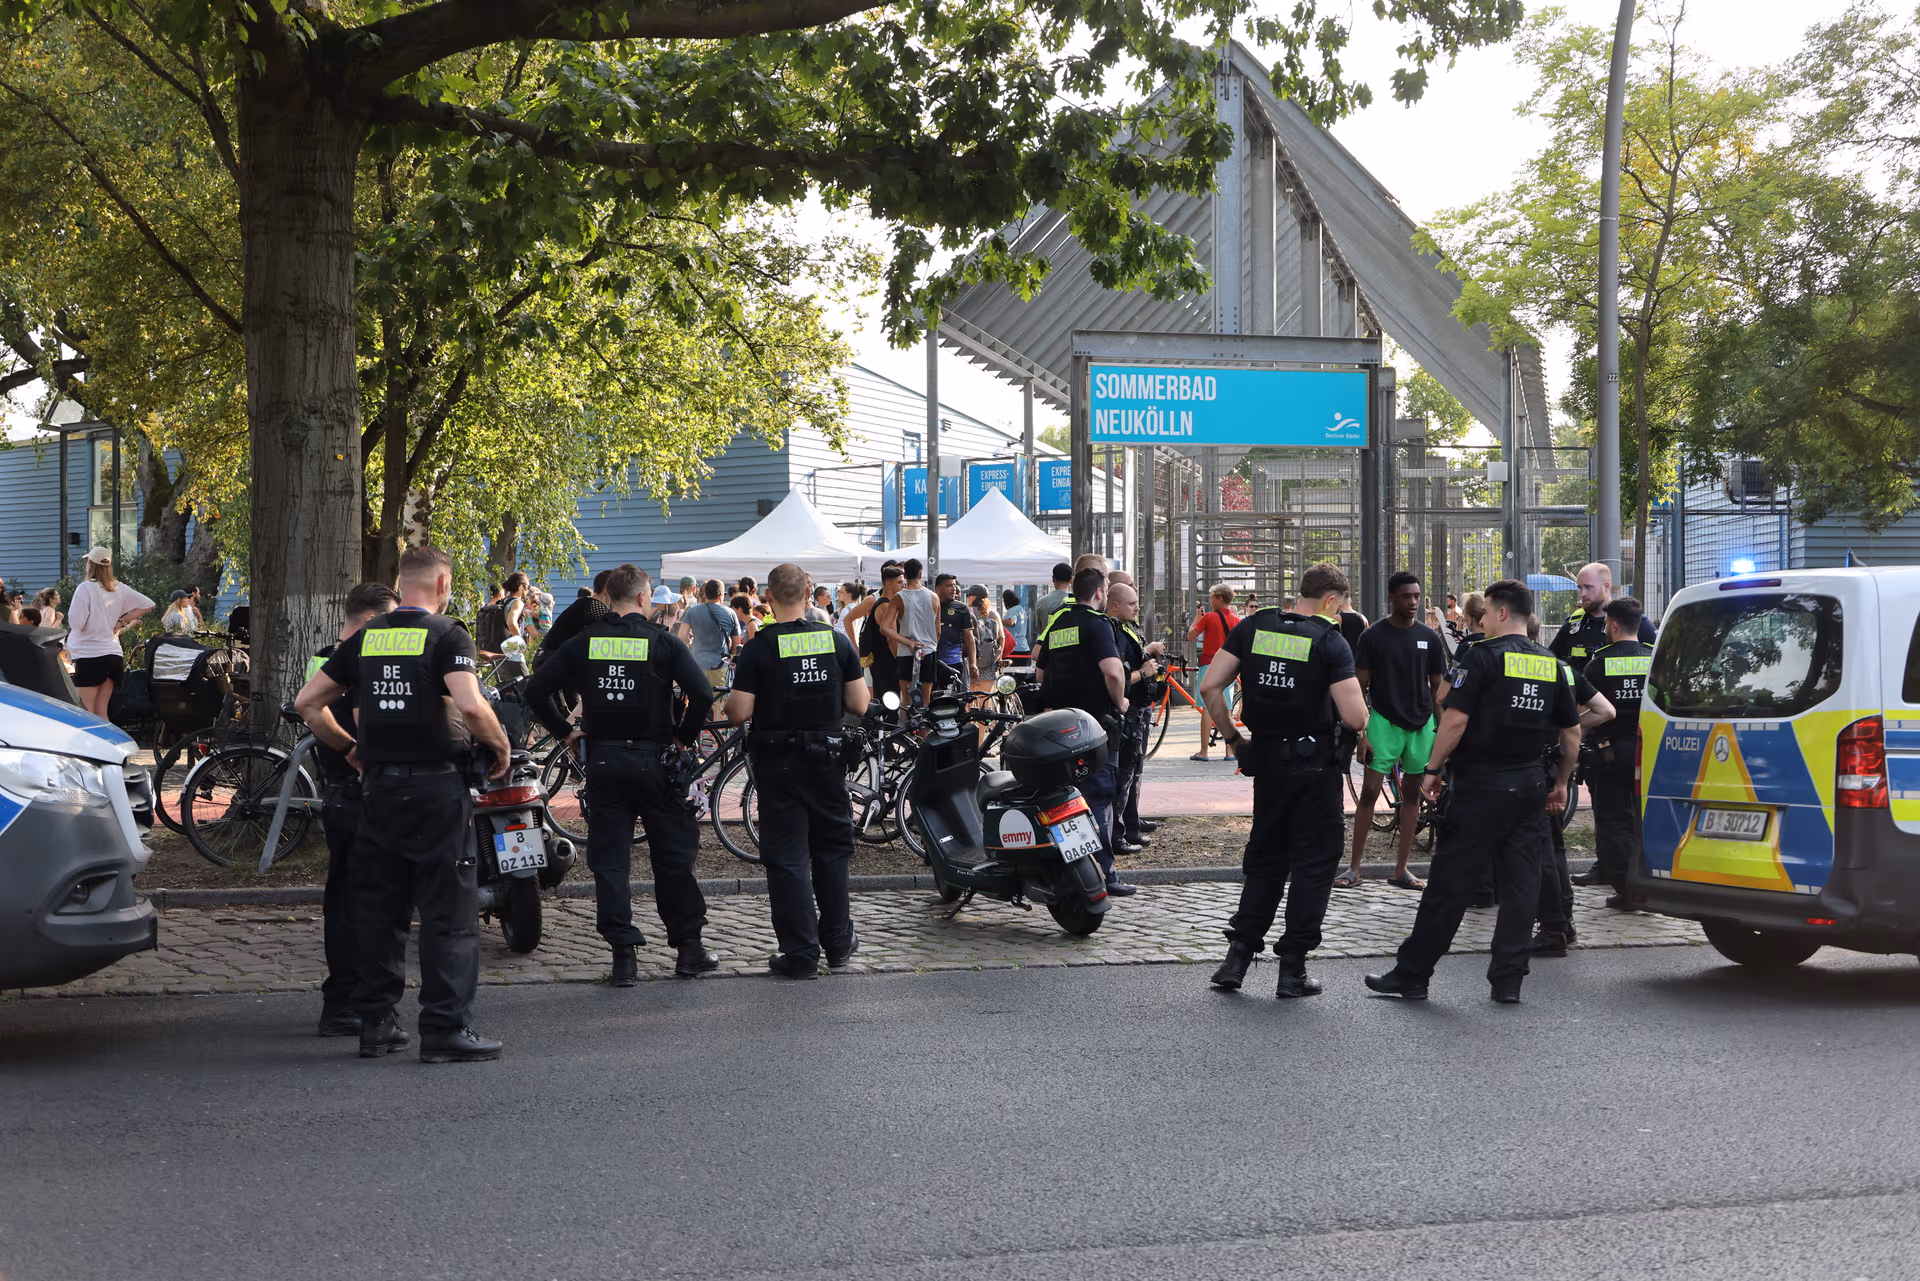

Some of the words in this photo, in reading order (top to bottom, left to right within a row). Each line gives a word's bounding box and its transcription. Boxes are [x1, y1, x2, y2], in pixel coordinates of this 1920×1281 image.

[1095, 373, 1217, 401] SOMMERBAD
[1095, 406, 1193, 436] NEUKÖLLN
[980, 470, 1010, 480] EXPRESS-
[1051, 466, 1071, 476] EXPRE
[914, 478, 944, 494] KAE
[1052, 478, 1071, 488] EINGA
[365, 631, 424, 652] POLIZEI
[779, 633, 833, 656] POLIZEI
[1050, 627, 1078, 648] POLIZEI
[591, 639, 646, 659] POLIZEI
[1254, 632, 1309, 660] POLIZEI
[383, 665, 400, 679] BE
[608, 665, 625, 677] BE
[801, 658, 818, 670] BE
[1269, 661, 1287, 674] BE
[1508, 656, 1554, 678] POLIZEI
[1607, 658, 1650, 674] POLIZE
[598, 677, 635, 691] 32110
[792, 670, 828, 684] 32116
[1258, 673, 1295, 689] 32114
[1623, 678, 1638, 689] BE
[372, 681, 412, 696] 32101
[1522, 683, 1539, 697] BE
[1510, 695, 1545, 711] 32112
[1665, 736, 1700, 752] POLIZEI
[1061, 820, 1078, 835] LG
[1705, 811, 1714, 831] B
[1723, 812, 1760, 834] 30712
[516, 832, 525, 843] B
[1002, 831, 1032, 845] emmy
[1064, 847, 1080, 862] QA
[1080, 839, 1101, 856] 681
[500, 857, 518, 872] QZ
[520, 853, 545, 868] 113
